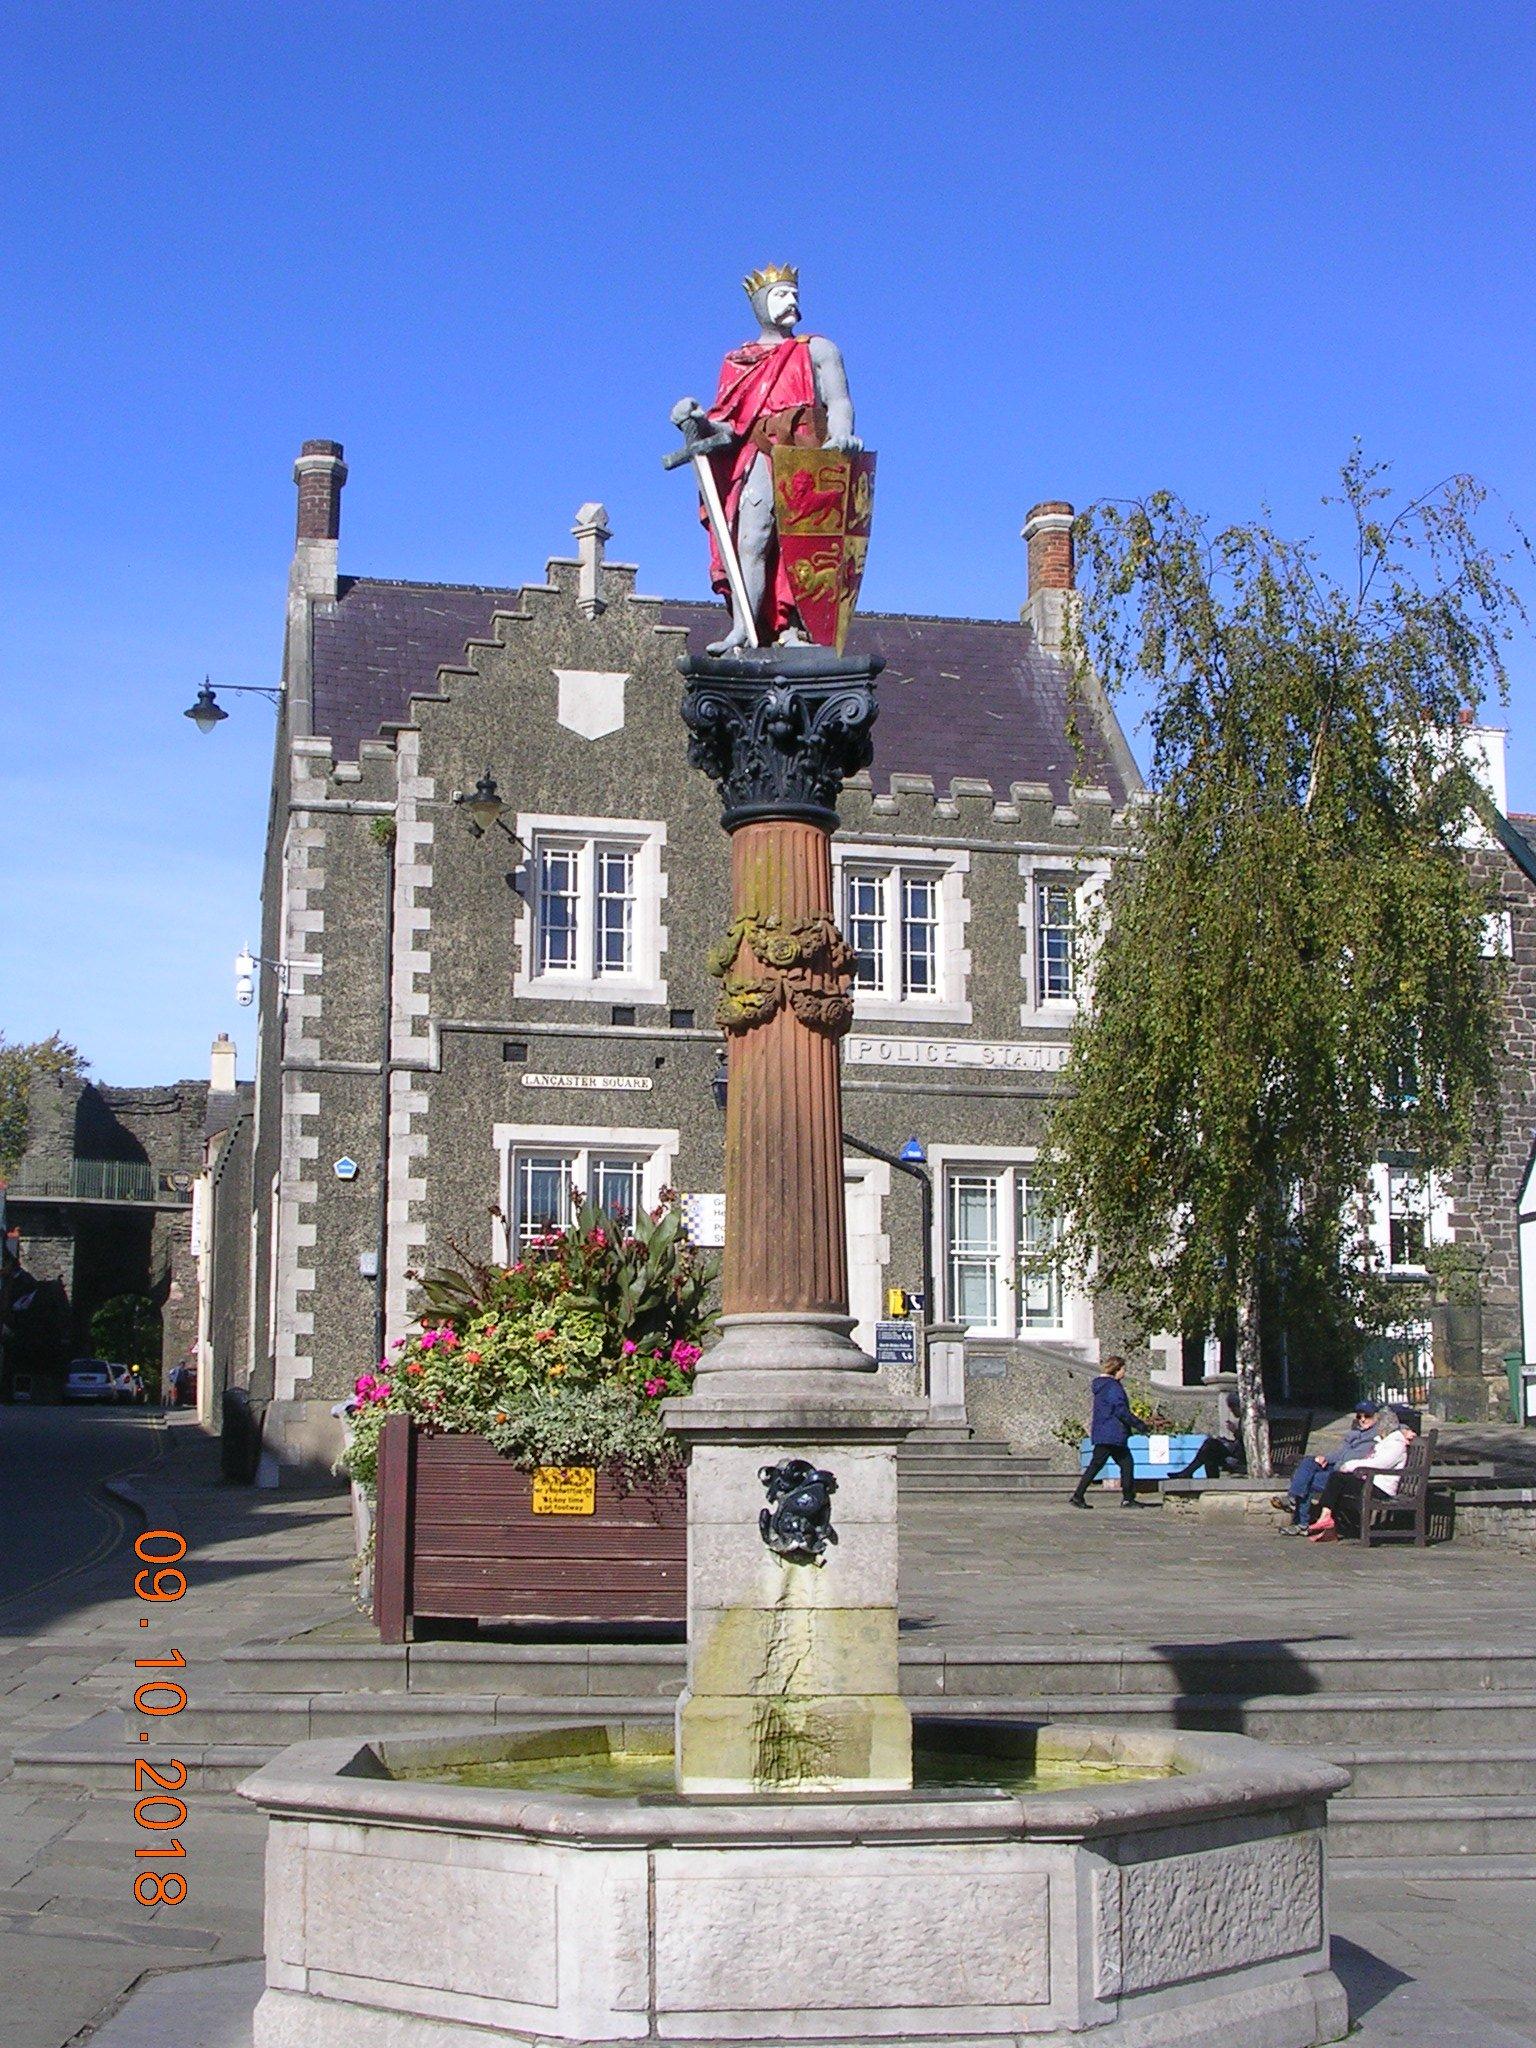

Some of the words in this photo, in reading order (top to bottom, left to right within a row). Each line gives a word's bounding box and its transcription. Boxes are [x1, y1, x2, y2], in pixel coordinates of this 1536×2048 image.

[857, 1041, 957, 1063] POLICE
[982, 1046, 1068, 1067] STATIO
[525, 1075, 597, 1087] LANCASTER
[602, 1078, 649, 1088] SQUARE
